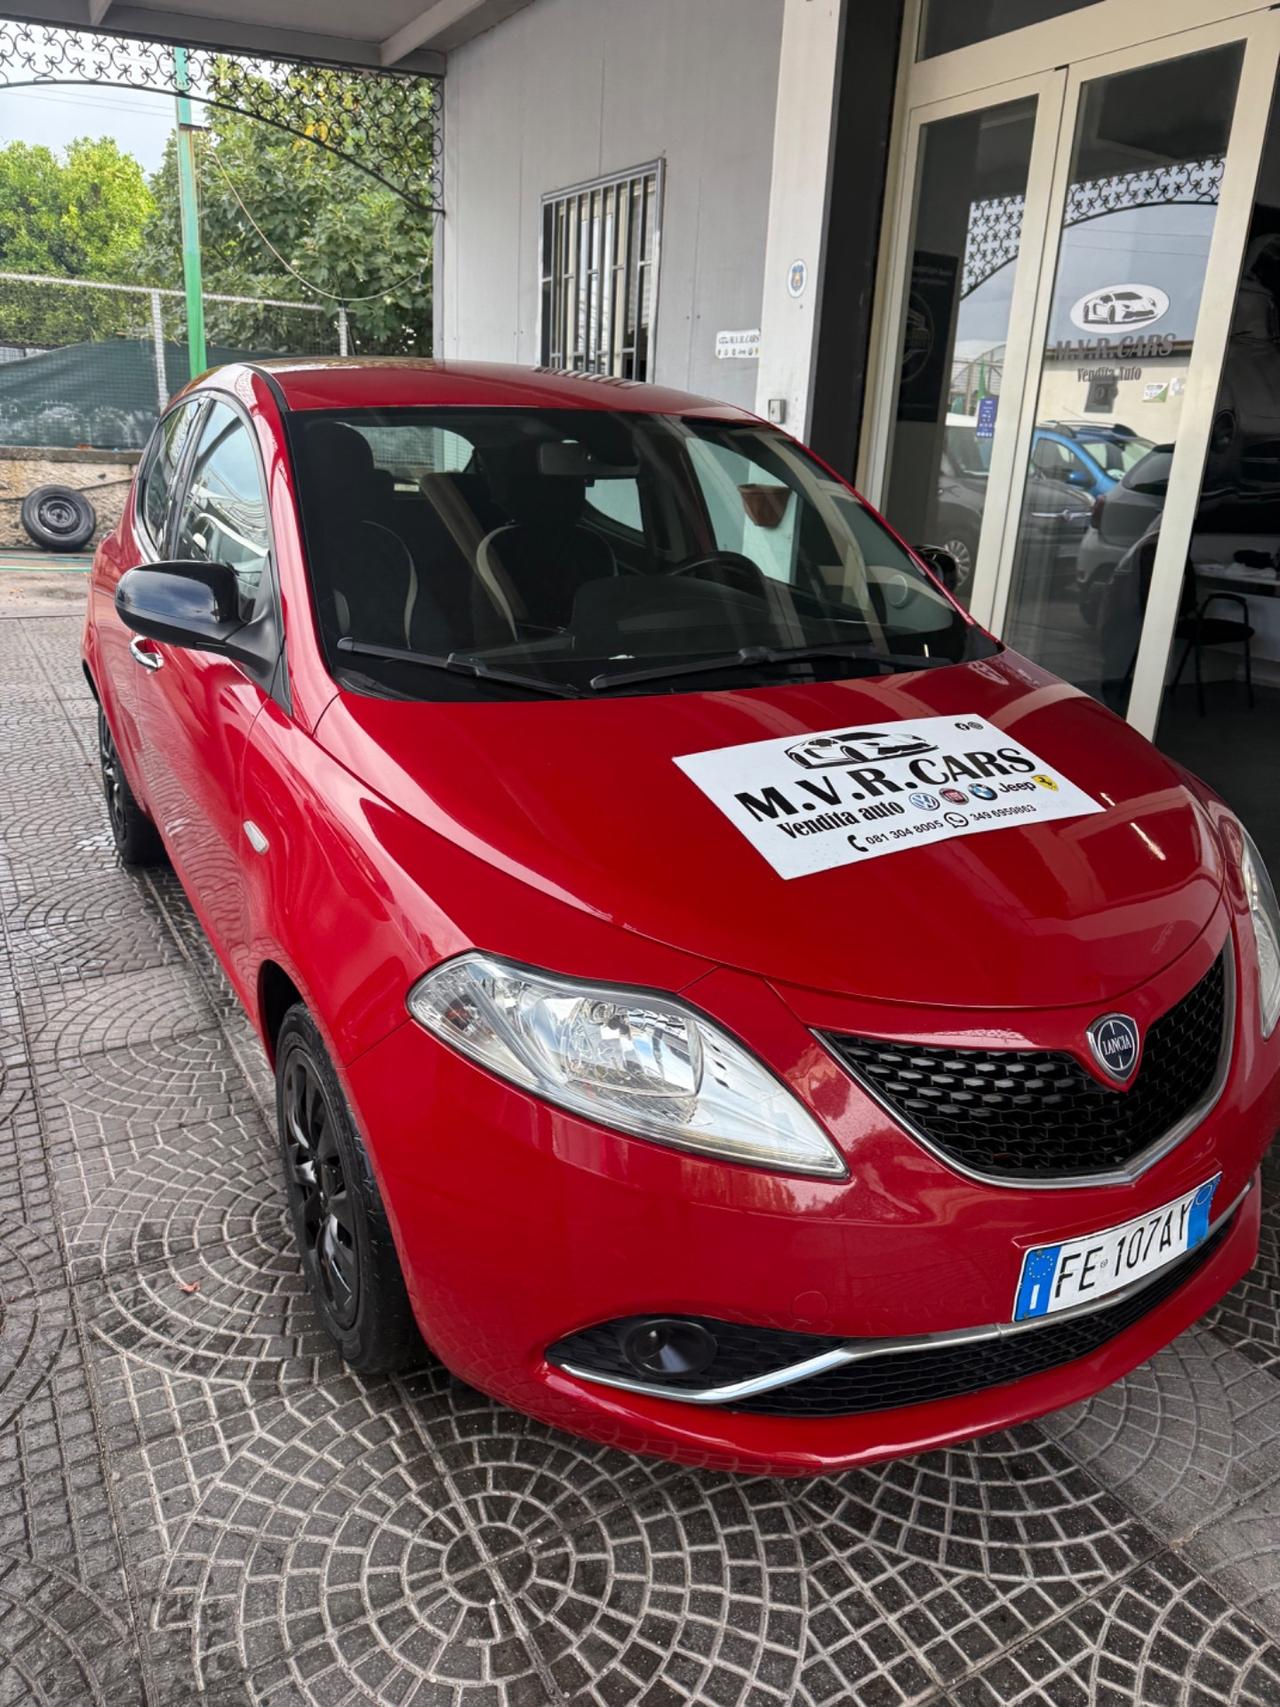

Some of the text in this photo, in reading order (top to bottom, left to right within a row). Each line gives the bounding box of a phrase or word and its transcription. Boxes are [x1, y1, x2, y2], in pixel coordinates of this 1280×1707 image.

[999, 781, 1036, 793] Jeep
[777, 801, 905, 839] Vendita auto
[969, 811, 992, 821] 349
[865, 819, 944, 845] 081 304 8005
[1102, 1034, 1132, 1056] LANCIA
[1054, 1246, 1104, 1298] FE
